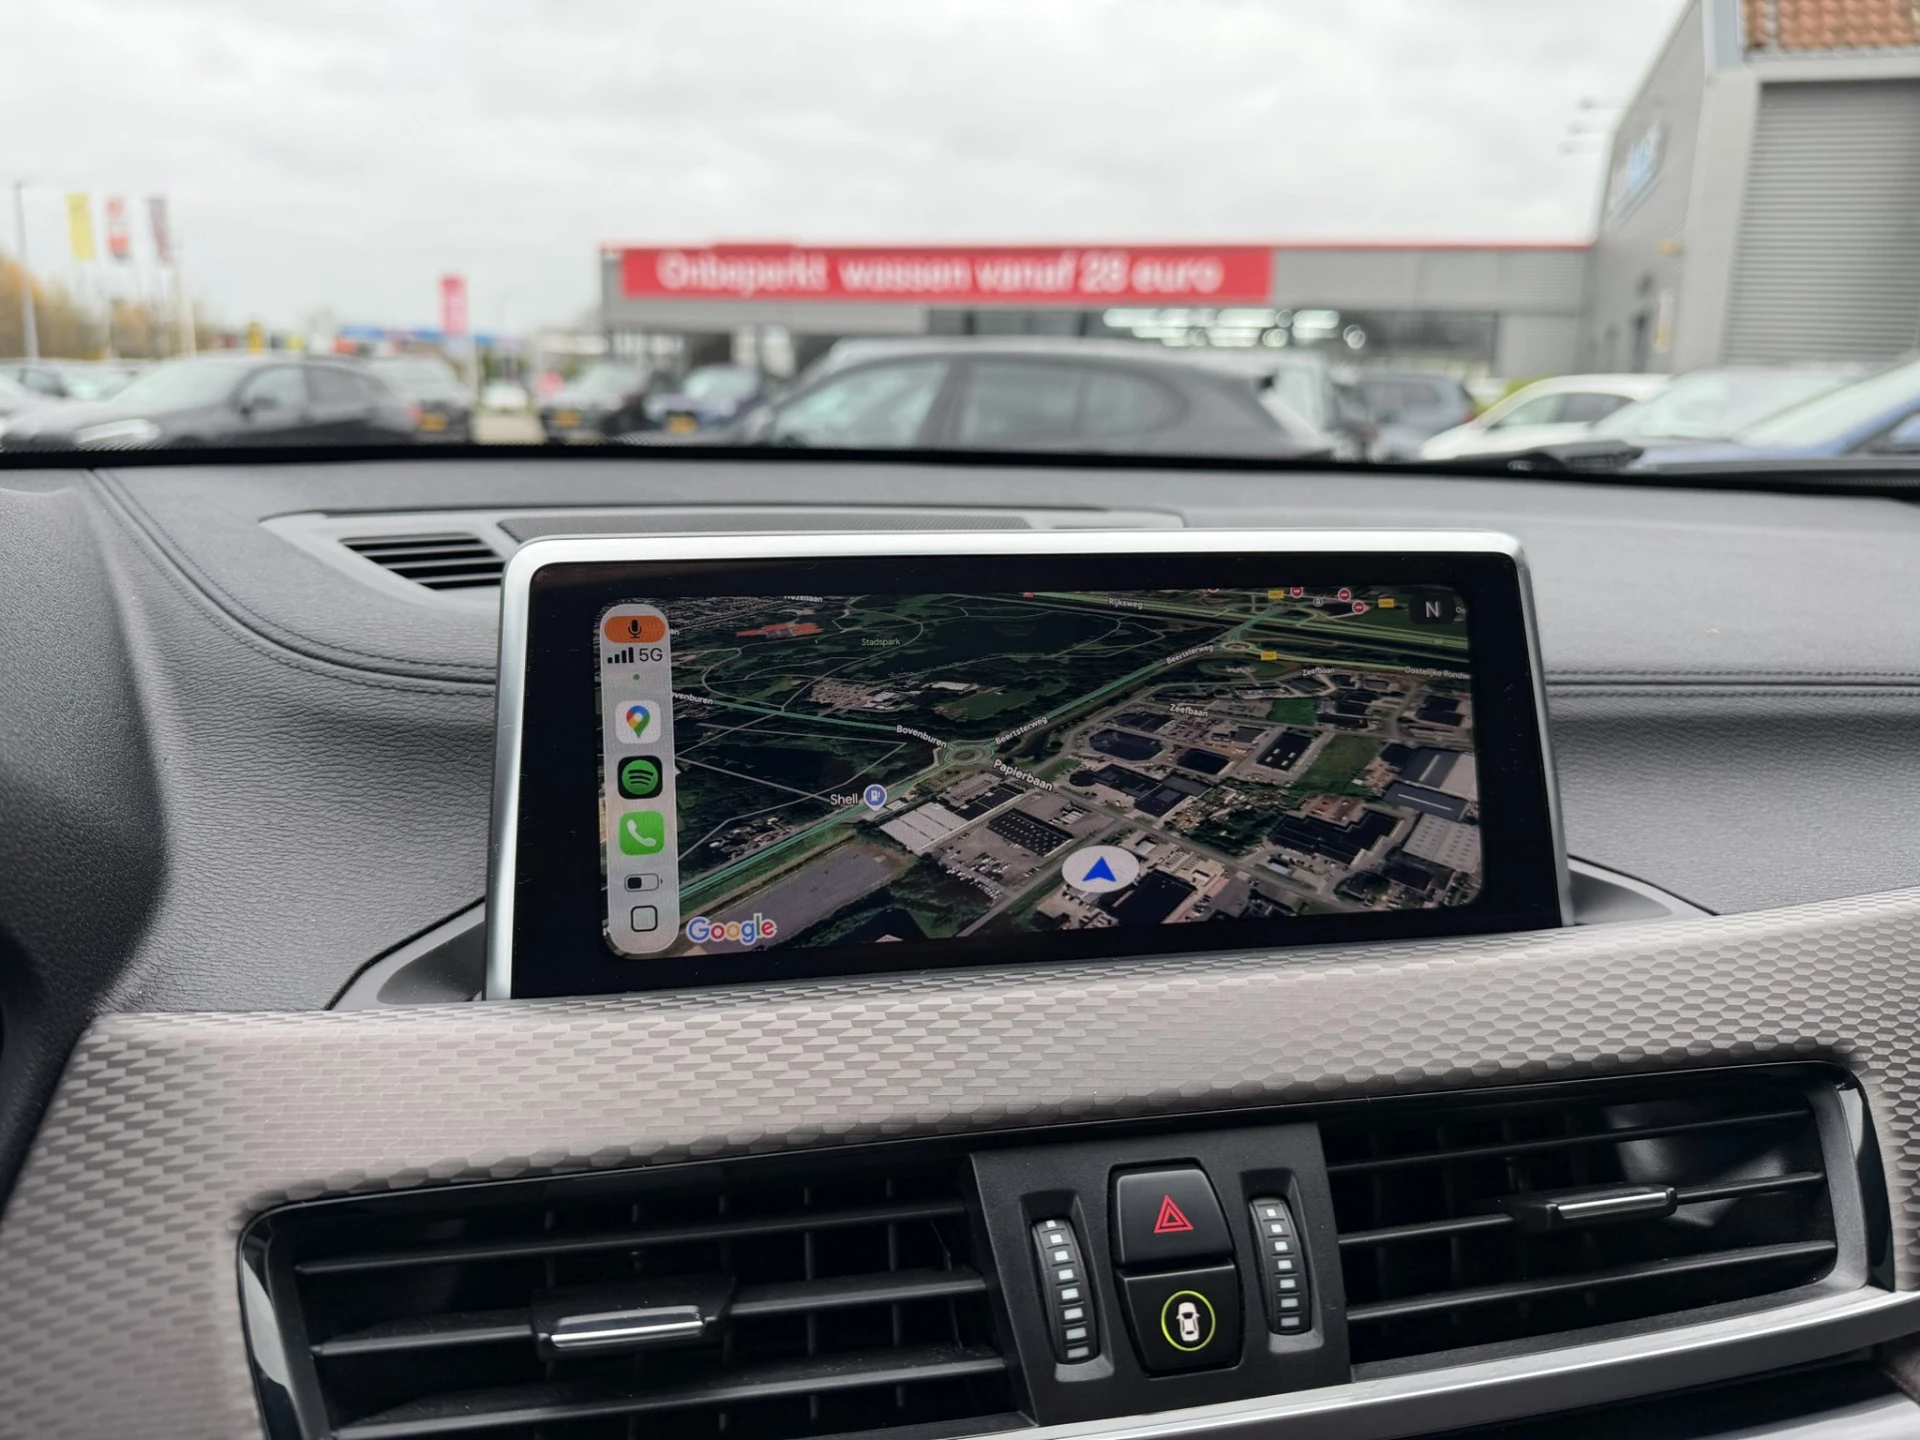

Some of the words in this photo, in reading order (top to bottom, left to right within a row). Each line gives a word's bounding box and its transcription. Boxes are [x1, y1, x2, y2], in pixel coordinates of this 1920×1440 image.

[656, 250, 829, 298] Onbeperkt
[838, 257, 972, 293] wassen
[973, 250, 1077, 293] vanaf
[1079, 250, 1130, 293] 28
[1132, 256, 1224, 293] euro
[1109, 598, 1143, 610] Rijksweg
[1425, 601, 1439, 618] N
[861, 638, 900, 647] Stadspark
[639, 648, 663, 662] 5G
[1302, 667, 1335, 677] Zeefbaan
[1404, 666, 1441, 677] Oostelijke
[671, 692, 714, 705] ovenburen
[1169, 703, 1208, 717] Zeefbaan
[896, 725, 947, 748] Bovenburen
[995, 716, 1048, 745] Beertsterweg
[993, 759, 1053, 791] Papierbaan
[830, 794, 858, 805] Shell
[687, 913, 777, 944] Google
